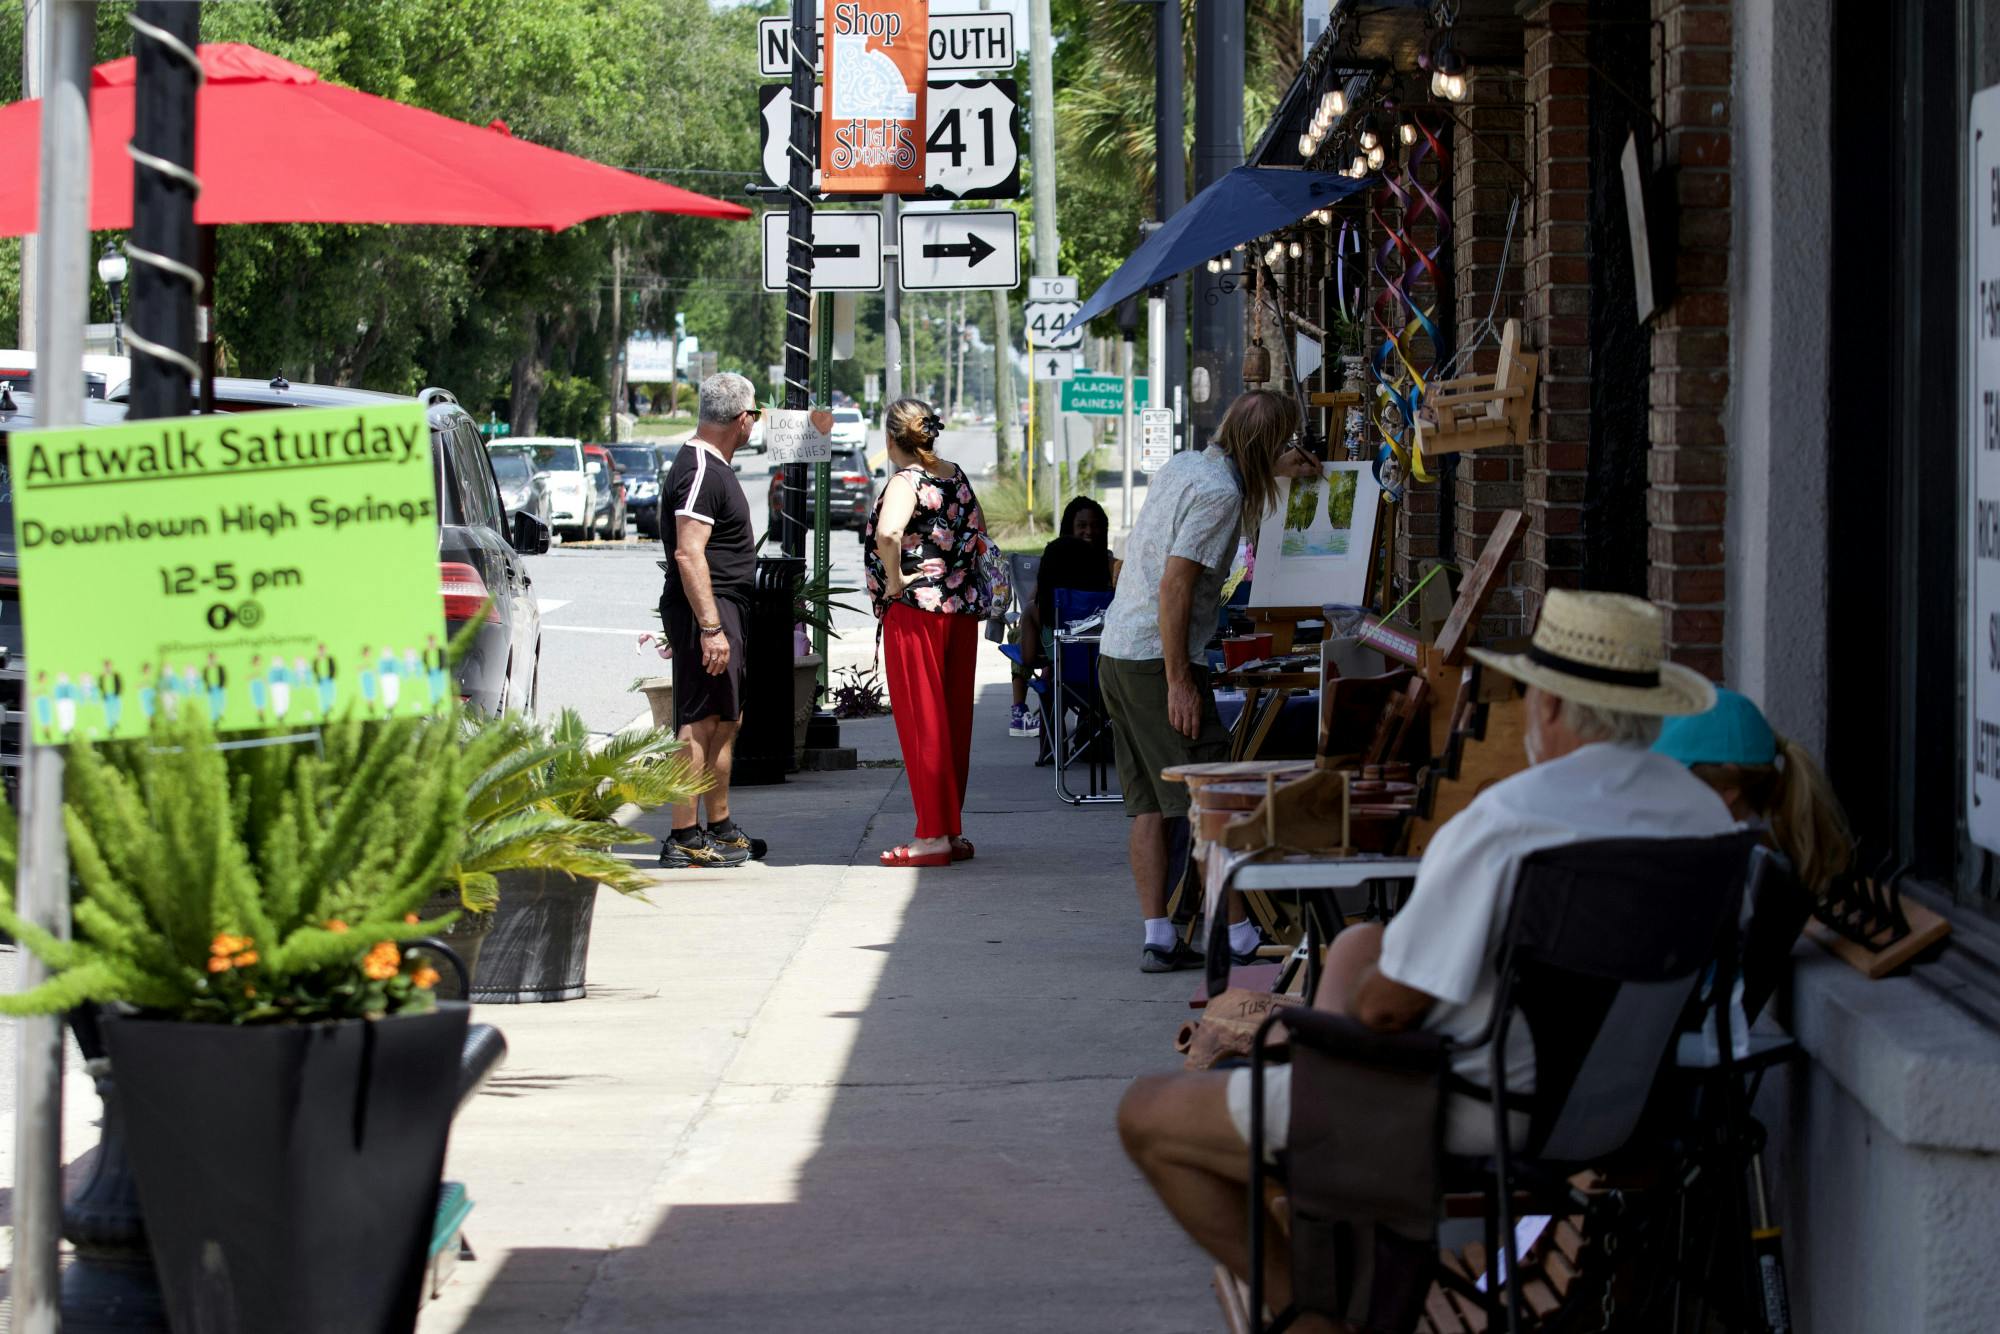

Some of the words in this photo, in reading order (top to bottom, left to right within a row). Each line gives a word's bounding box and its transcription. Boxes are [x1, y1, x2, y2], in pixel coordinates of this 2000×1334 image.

[834, 3, 901, 46] Shop
[928, 28, 1006, 60] OUTH
[926, 107, 994, 167] 41
[1042, 282, 1064, 295] TO
[1072, 382, 1123, 393] ALACHU
[26, 431, 204, 481] Artwalk
[218, 416, 421, 463] Saturday
[771, 445, 826, 461] PEACHES
[22, 512, 208, 548] Downtown
[220, 503, 298, 537] High
[309, 494, 431, 532] Springs
[160, 562, 237, 595] 12-5
[250, 566, 301, 593] pm
